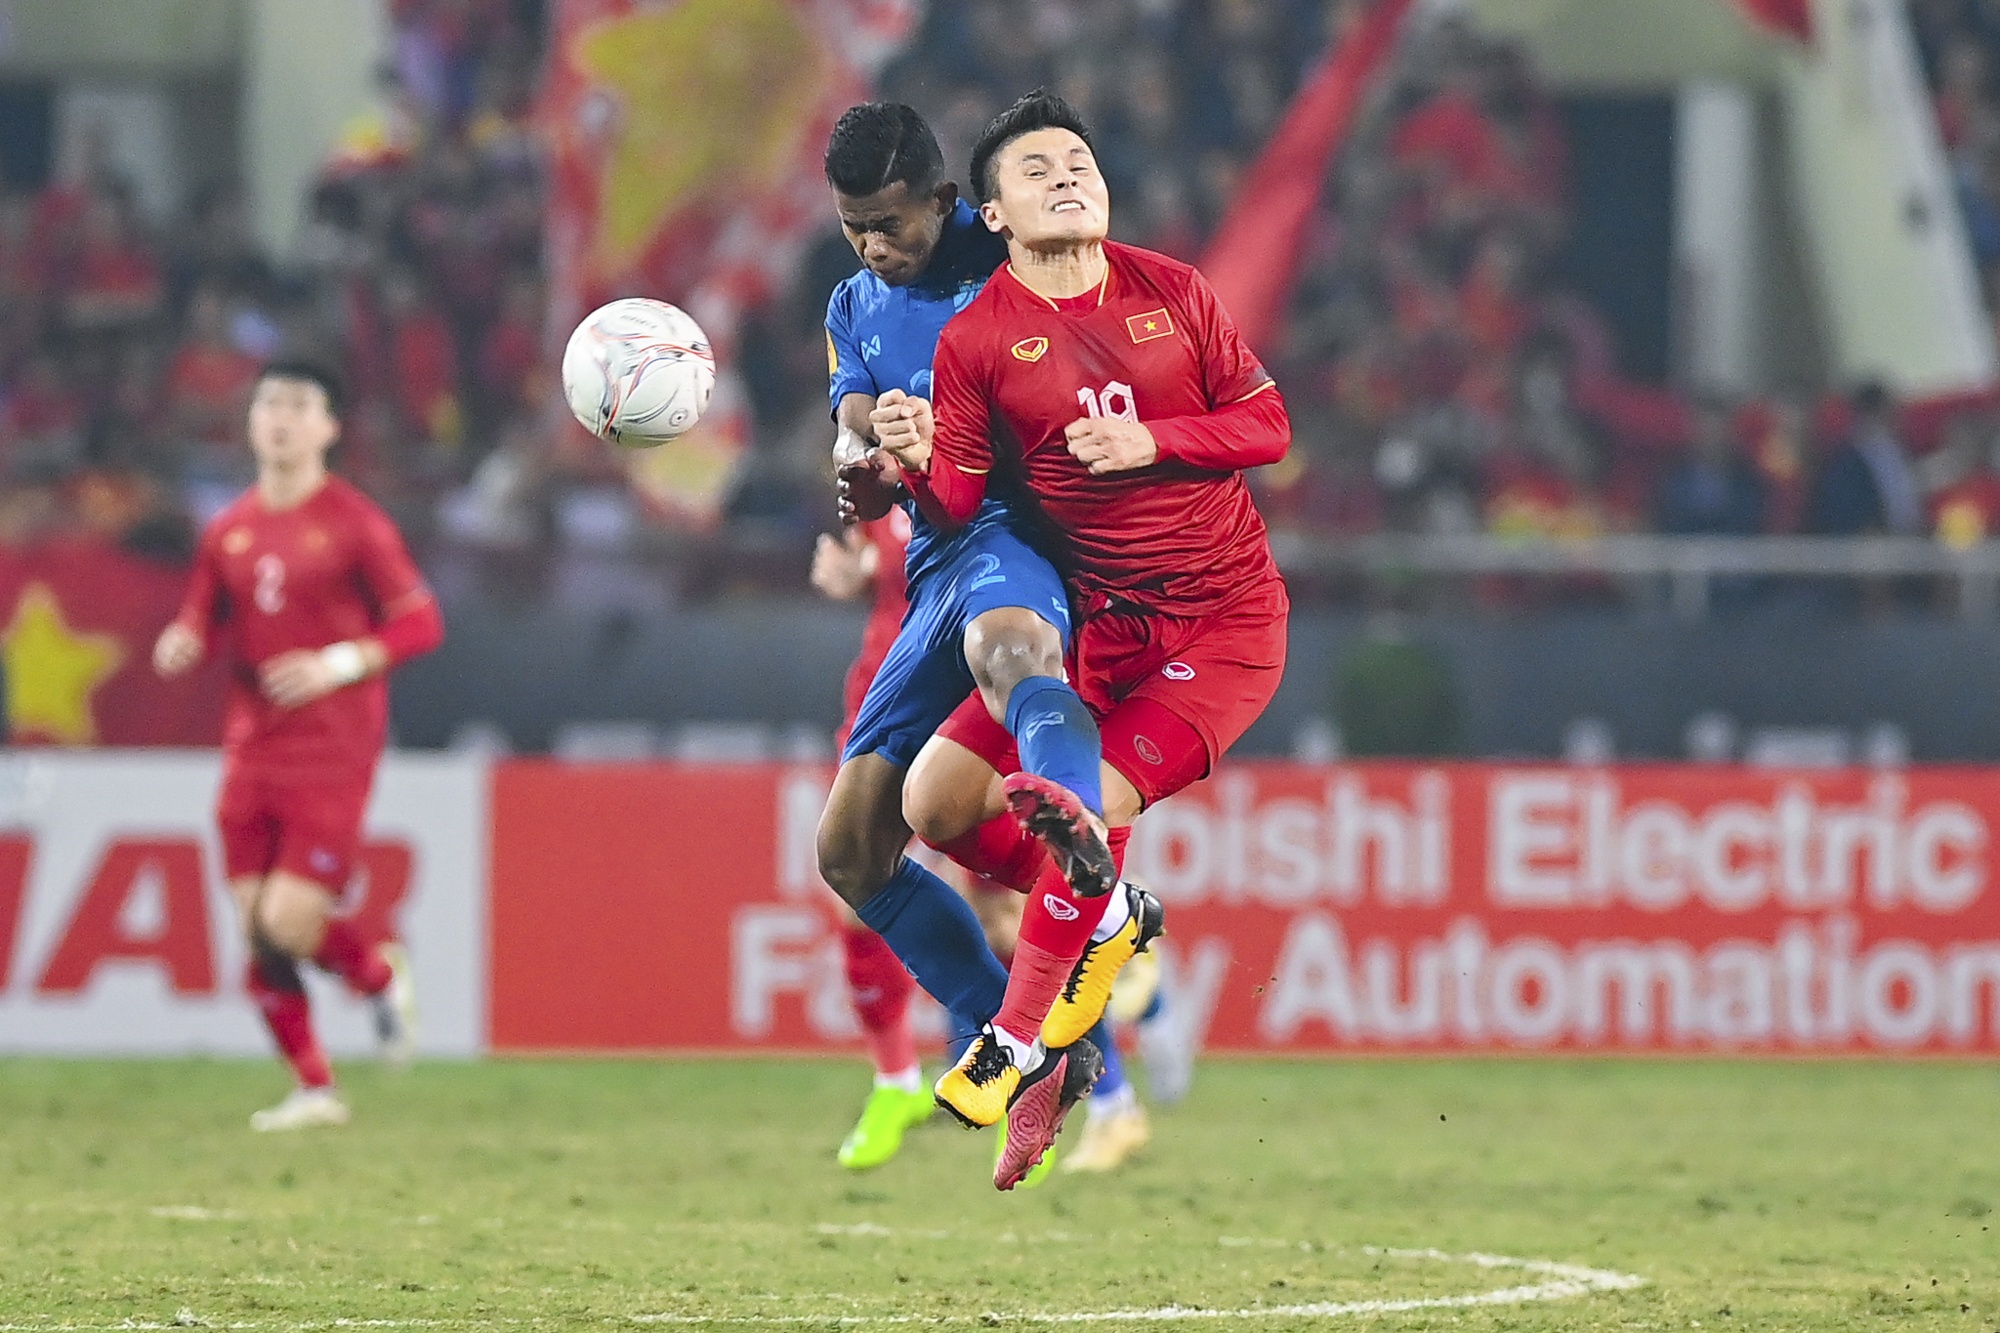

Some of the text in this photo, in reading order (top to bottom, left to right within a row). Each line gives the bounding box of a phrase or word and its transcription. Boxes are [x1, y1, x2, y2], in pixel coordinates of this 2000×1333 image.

[1076, 380, 1139, 423] 19
[966, 552, 1006, 592] 2
[1489, 773, 1986, 908] Electric
[1262, 914, 2000, 1040] Automation
